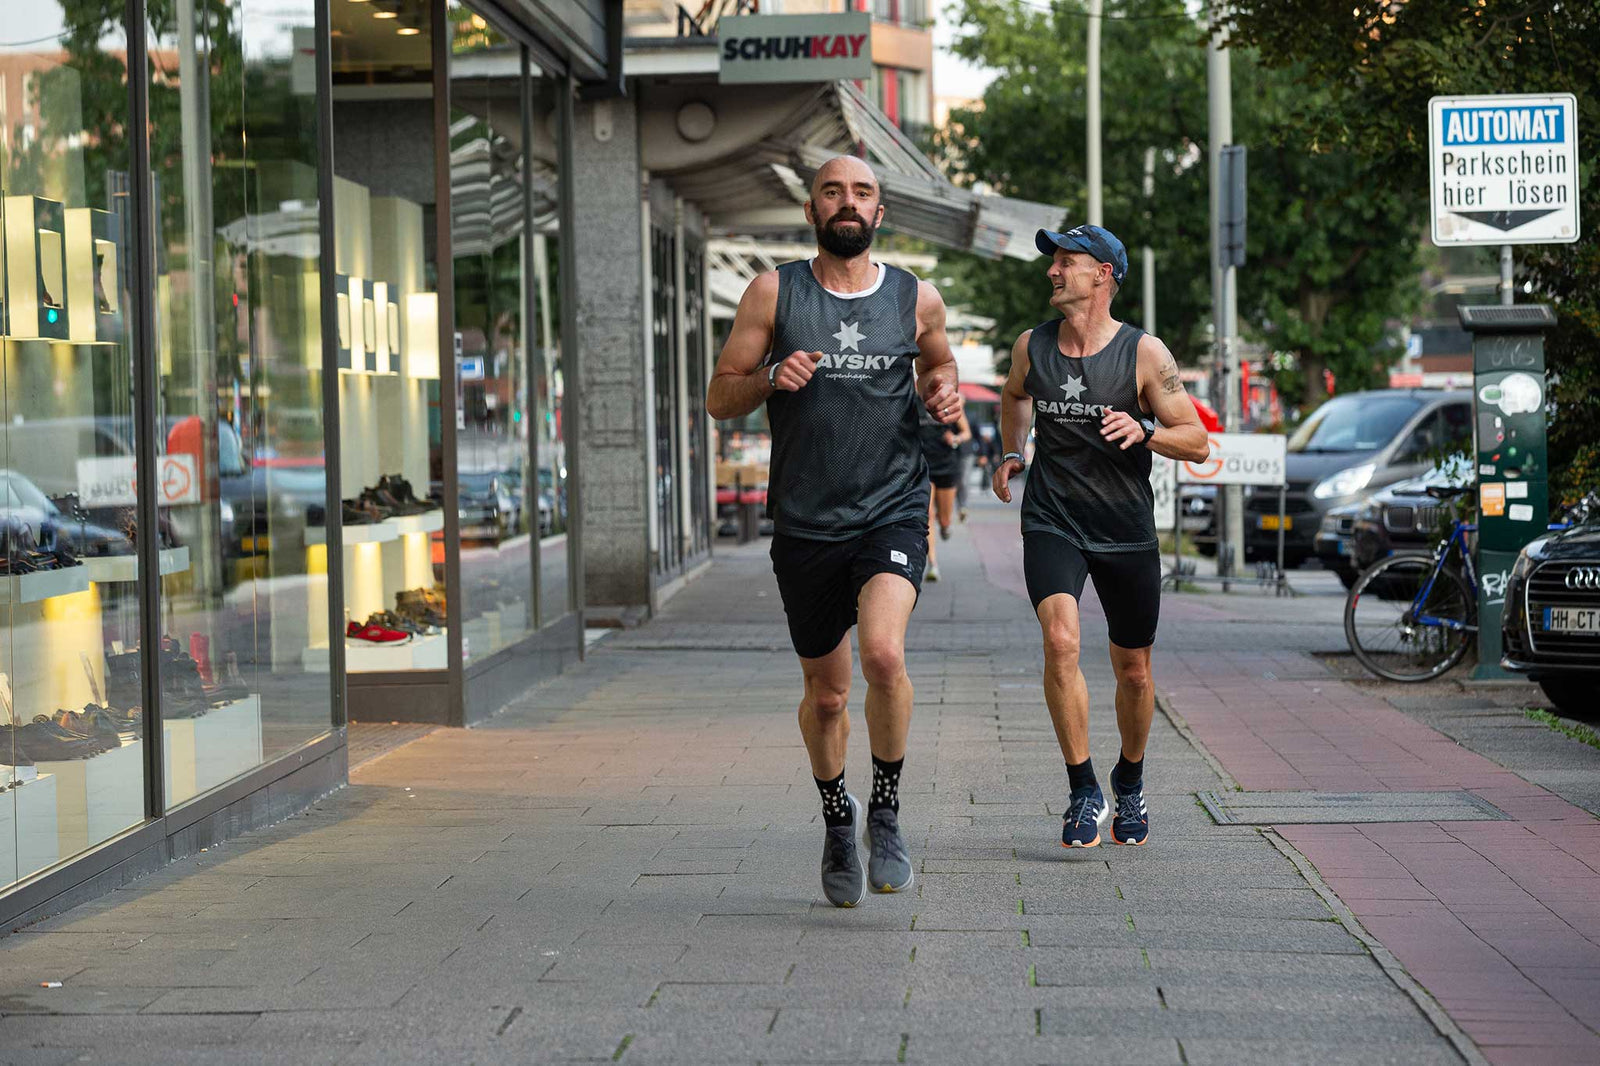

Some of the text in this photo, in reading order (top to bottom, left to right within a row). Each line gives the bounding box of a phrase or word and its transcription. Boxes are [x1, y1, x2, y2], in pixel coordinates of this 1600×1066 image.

[723, 34, 867, 60] SCHUHKAY
[1447, 108, 1560, 143] AUTOMAT
[1442, 149, 1567, 176] Parkschein
[1443, 179, 1568, 207] hier lösen
[816, 353, 898, 370] AYSKY
[825, 371, 873, 381] copenhagen
[1551, 610, 1569, 629] HH
[1577, 610, 1596, 630] CT
